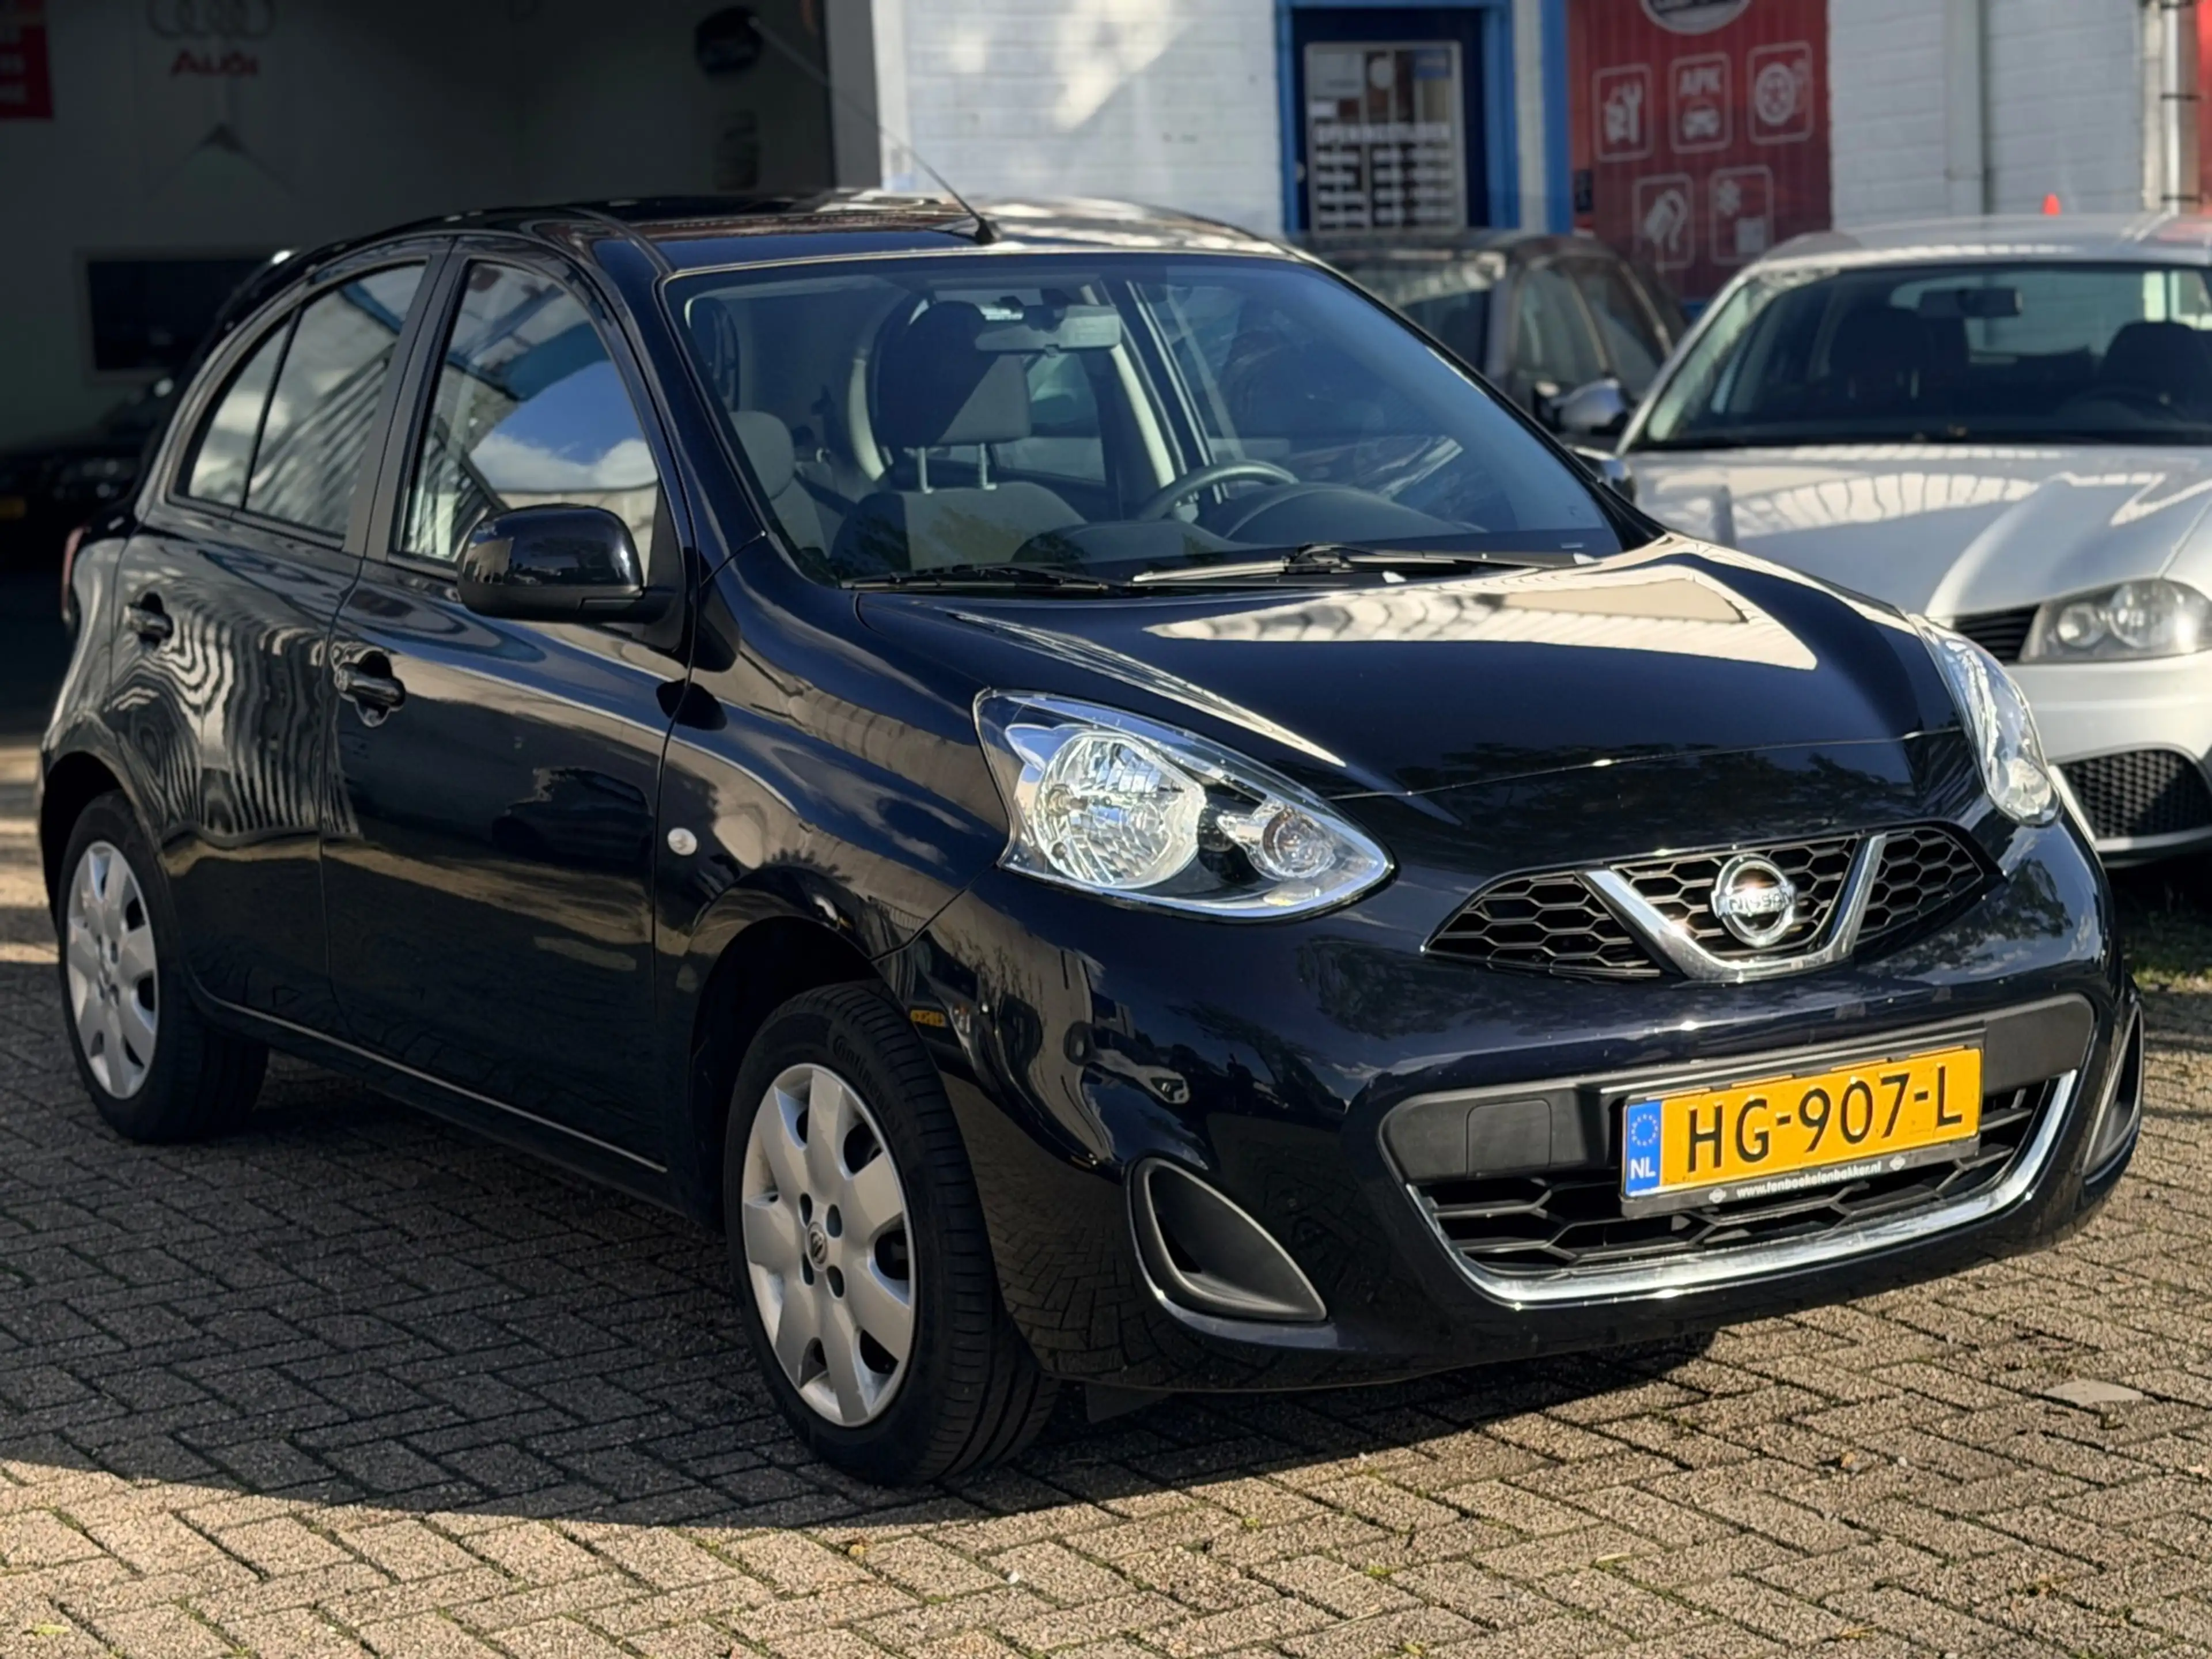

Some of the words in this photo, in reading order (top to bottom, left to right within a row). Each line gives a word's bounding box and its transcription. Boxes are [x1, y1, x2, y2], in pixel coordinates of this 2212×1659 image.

[169, 49, 259, 78] Audi
[1687, 1062, 1964, 1173] HG-907-L
[1629, 1158, 1657, 1179] NL
